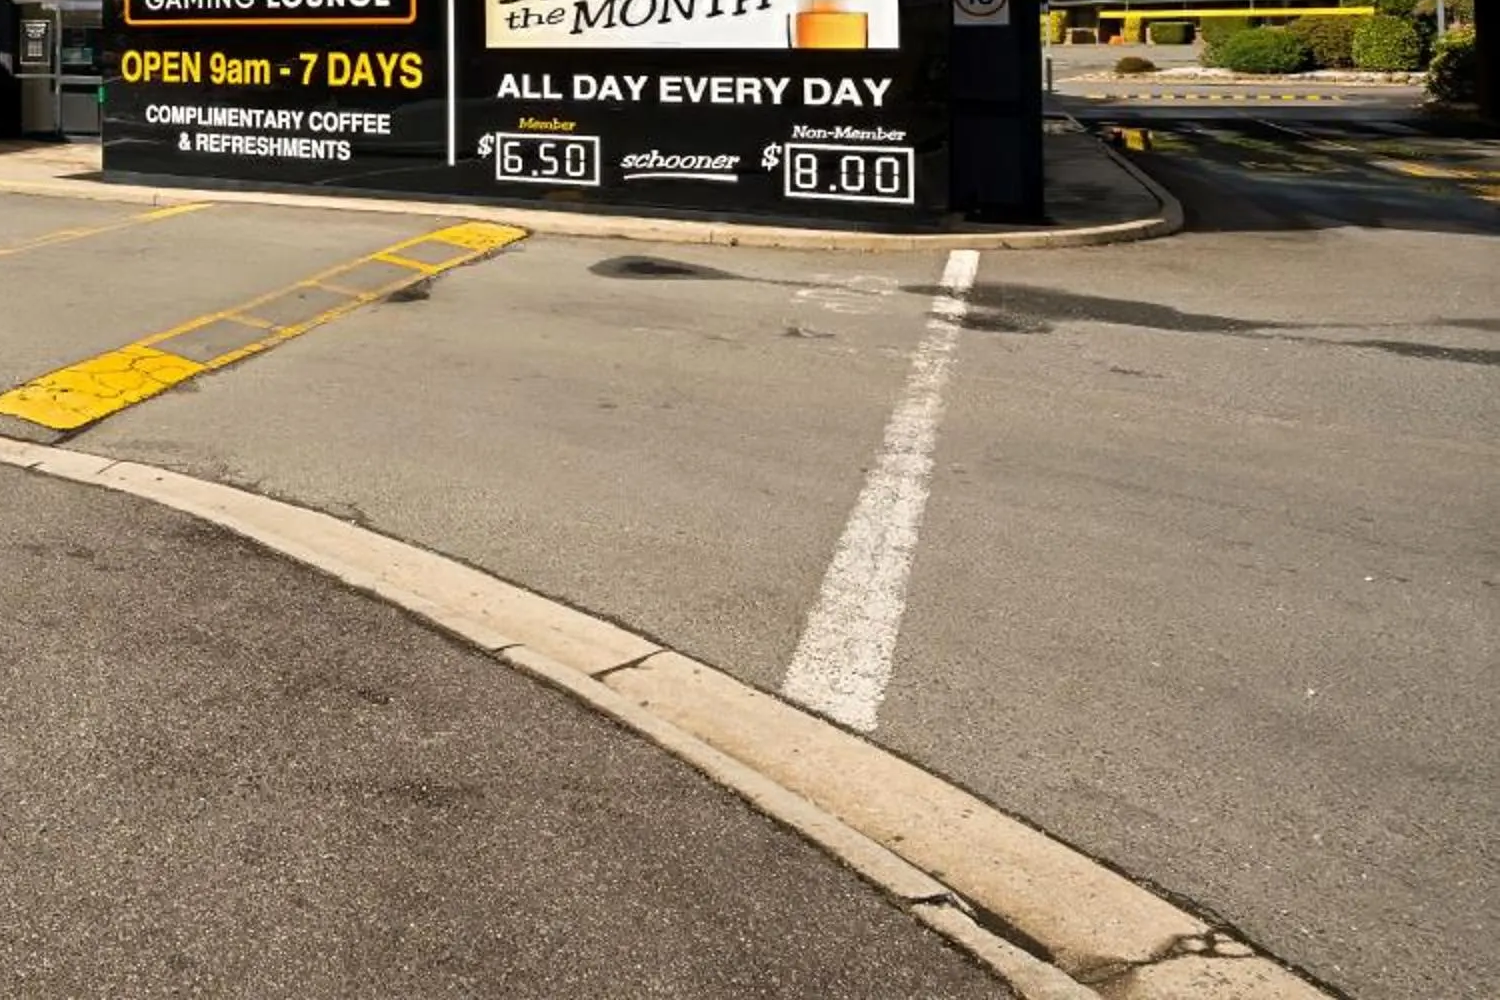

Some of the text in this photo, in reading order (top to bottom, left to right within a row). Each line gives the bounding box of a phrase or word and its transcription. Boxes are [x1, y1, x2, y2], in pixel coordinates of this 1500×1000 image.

[505, 7, 566, 31] the
[121, 50, 201, 83] OPEN
[209, 52, 271, 85] 9am
[299, 53, 318, 85] 7
[327, 52, 423, 88] DAYS
[497, 73, 892, 107] ALL DAY EVERY DAY
[145, 104, 391, 135] COMPLIMENTARY COFFEE
[518, 117, 577, 132] Member
[792, 125, 907, 141] Non-Member
[178, 131, 351, 161] & REFRESHMENTS
[620, 149, 741, 170] schooner
